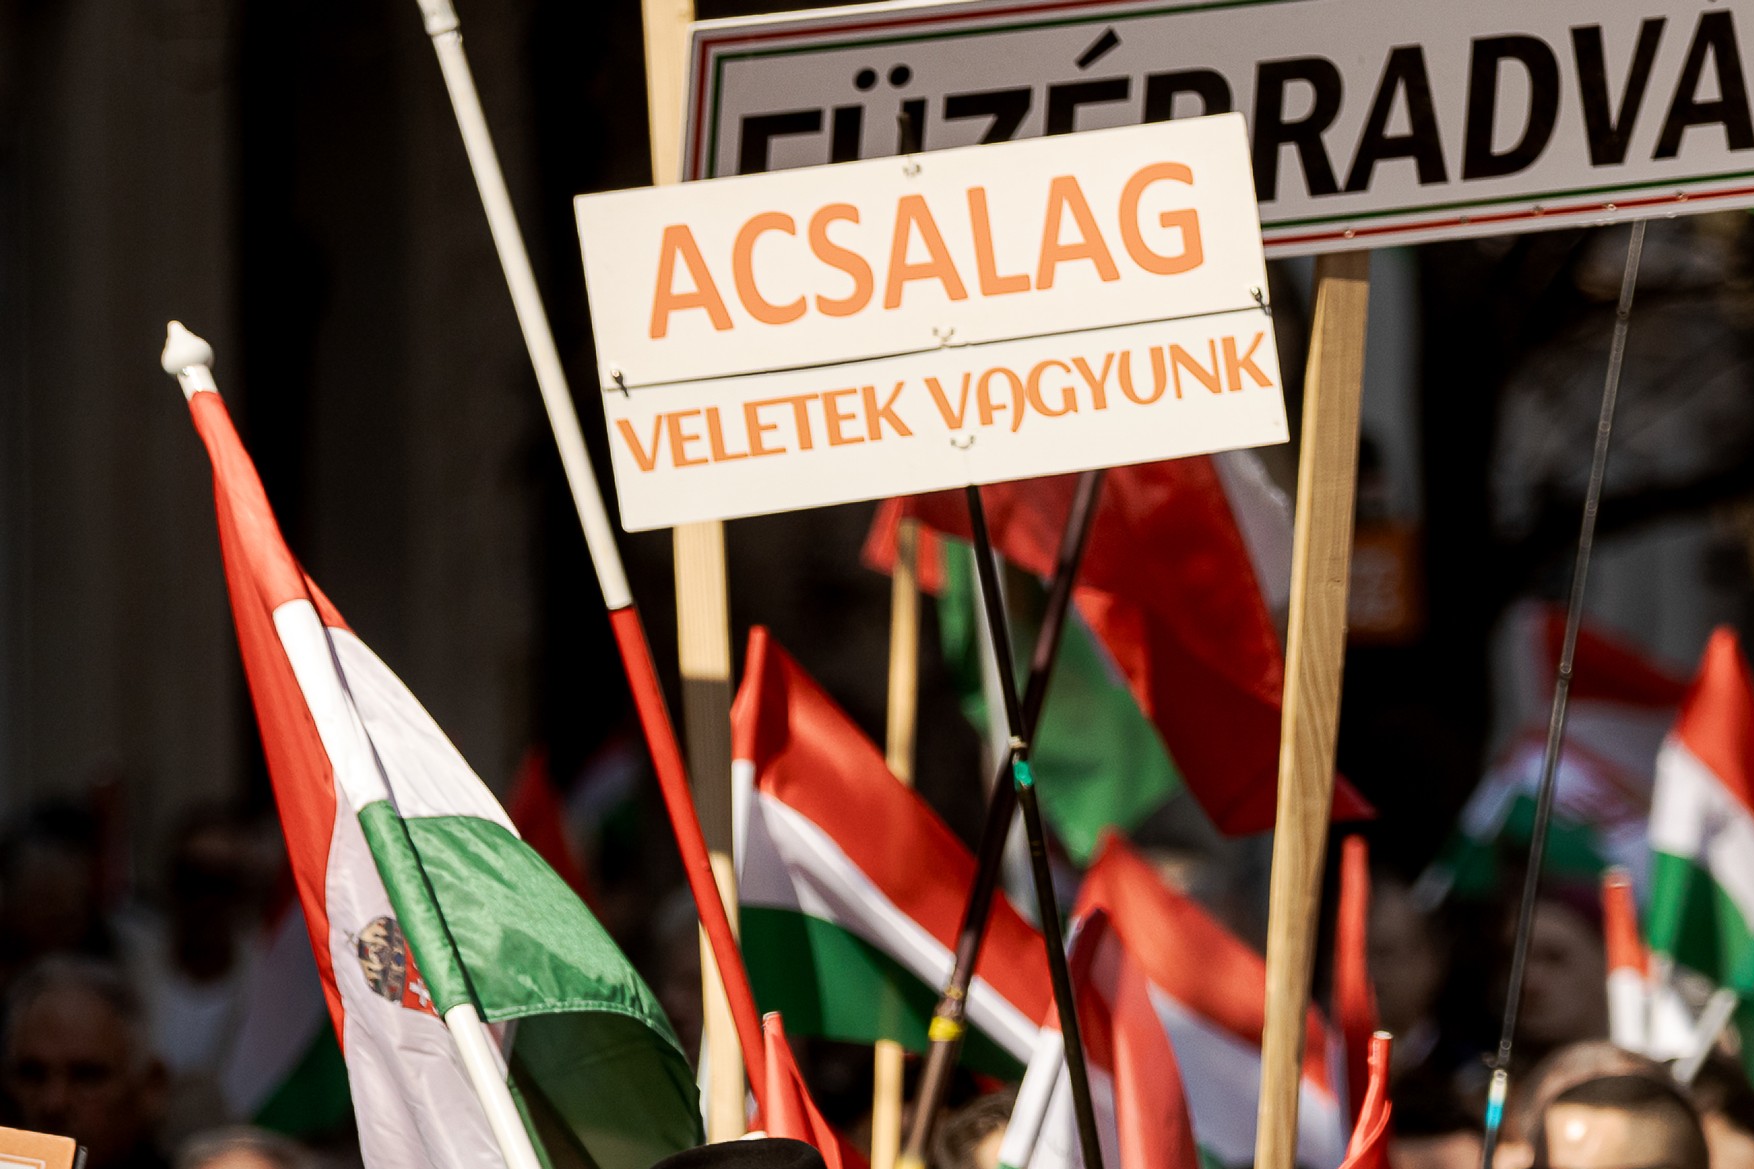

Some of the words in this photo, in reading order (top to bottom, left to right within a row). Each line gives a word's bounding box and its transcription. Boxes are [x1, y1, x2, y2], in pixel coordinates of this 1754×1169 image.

[648, 161, 1206, 342] ACSALAG
[614, 380, 914, 474] VELETEK
[922, 330, 1275, 434] VAGYUNK
